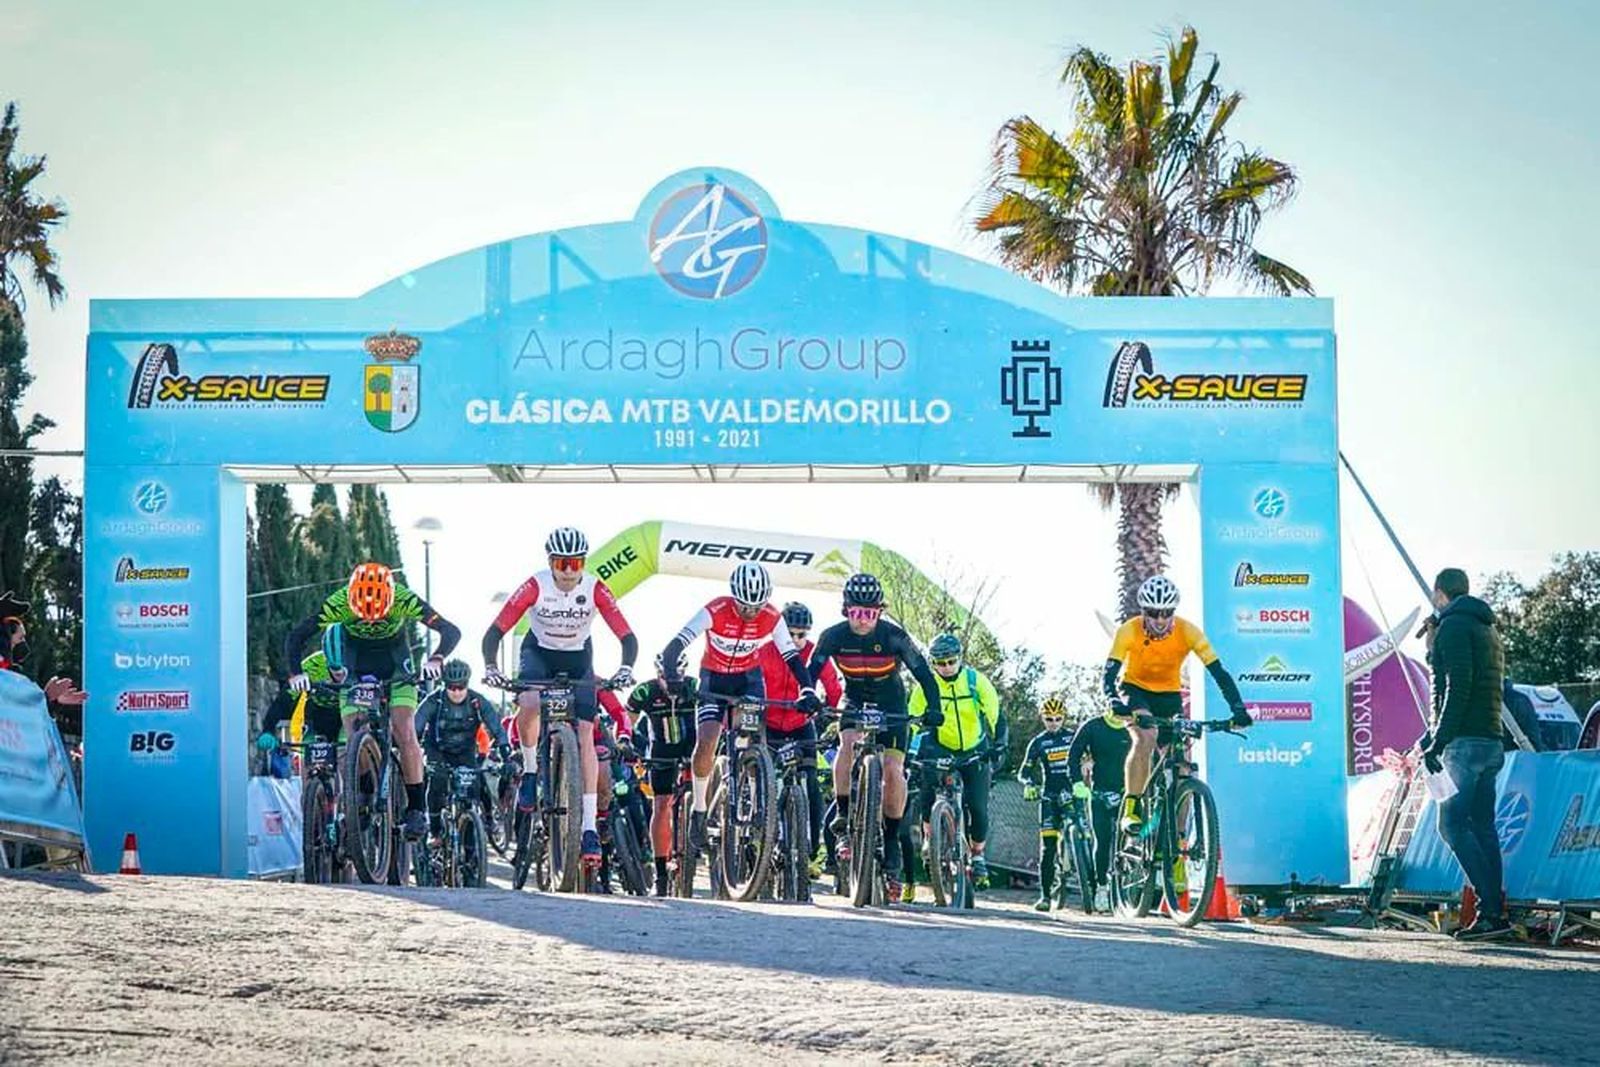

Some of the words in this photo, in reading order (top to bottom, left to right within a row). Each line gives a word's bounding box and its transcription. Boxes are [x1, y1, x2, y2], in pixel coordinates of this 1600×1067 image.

[512, 327, 907, 380] ArdaghGroup
[158, 374, 330, 402] X-SAUCE
[1132, 374, 1308, 402] X-SAUCE
[465, 391, 613, 424] CLÁSICA
[620, 399, 691, 423] MTB
[700, 398, 952, 424] VALDEMORILLO
[654, 429, 696, 448] 1991
[718, 429, 762, 448] 2021
[664, 539, 815, 566] MERIDA
[596, 546, 638, 582] BIKE
[139, 604, 189, 617] BOSCH
[1259, 610, 1310, 622] BOSCH
[135, 653, 191, 669] bryton
[1237, 673, 1312, 683] MERIDA
[546, 699, 568, 711] 329
[1238, 747, 1303, 766] lastlap
